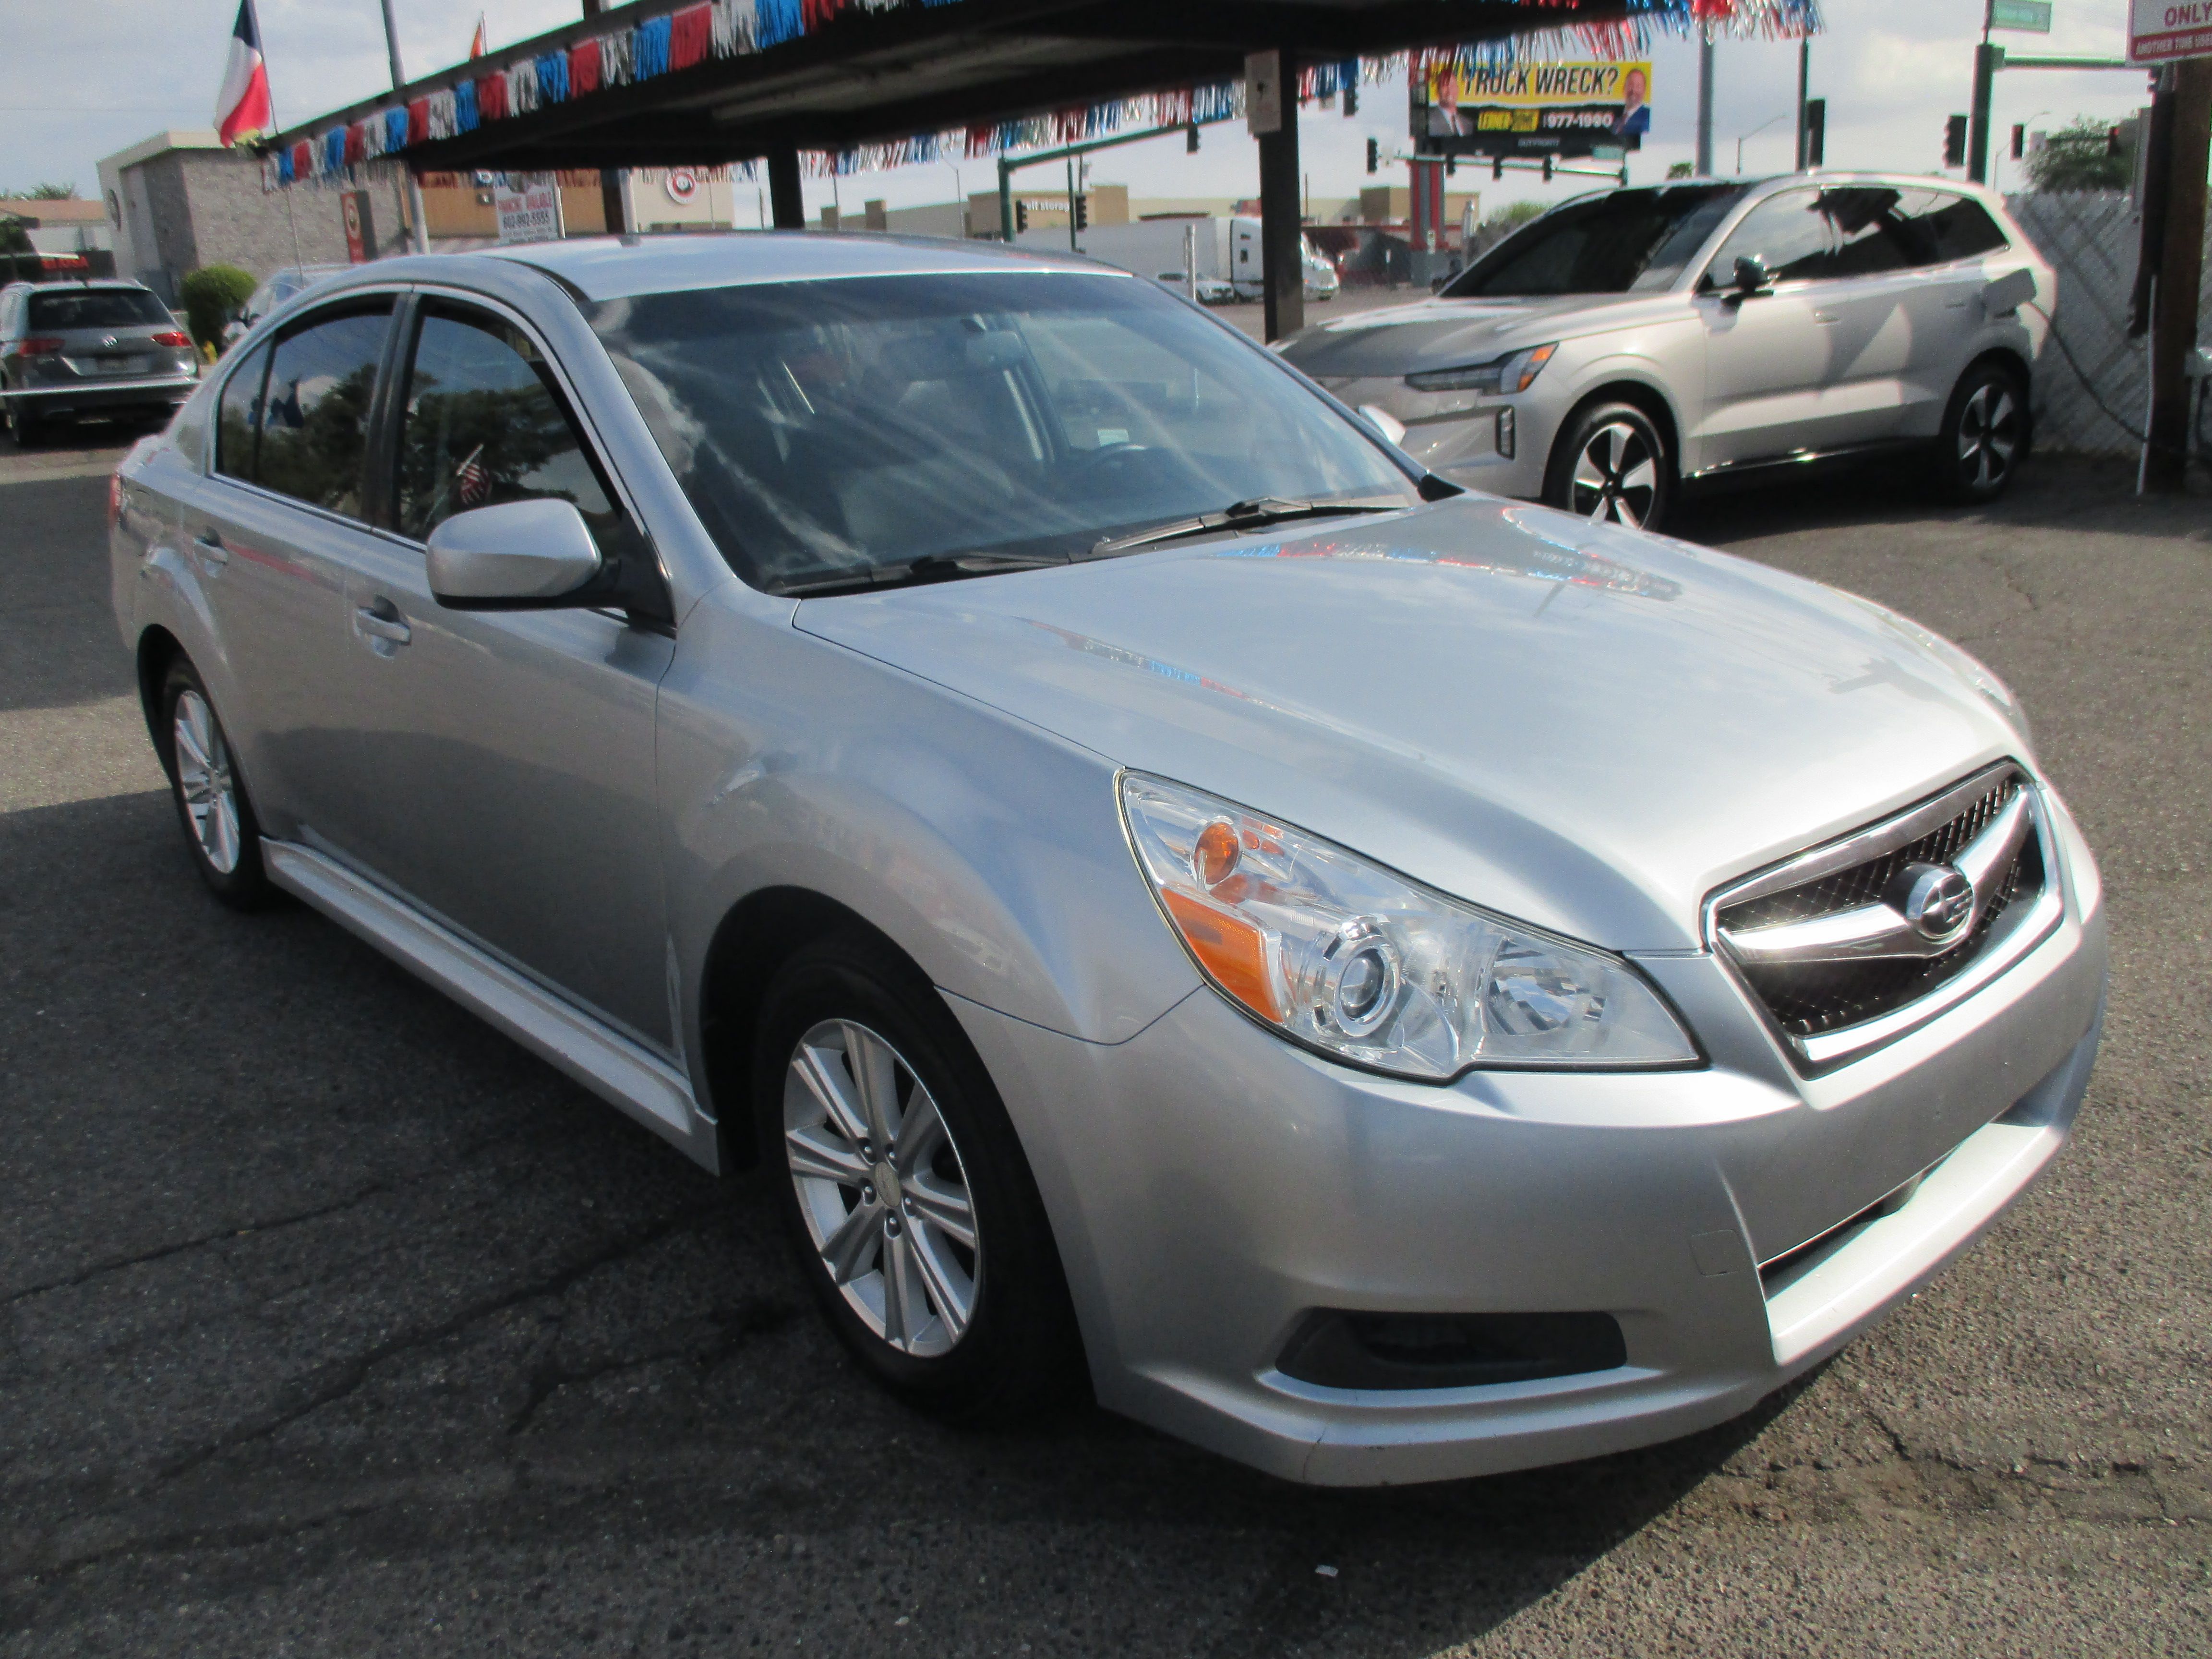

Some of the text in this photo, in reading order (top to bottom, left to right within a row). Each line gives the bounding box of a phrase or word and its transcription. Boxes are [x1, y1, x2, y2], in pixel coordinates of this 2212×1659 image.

[2164, 2, 2212, 27] ONLY
[1535, 66, 1619, 95] WRECK?
[1040, 200, 1070, 212] storag
